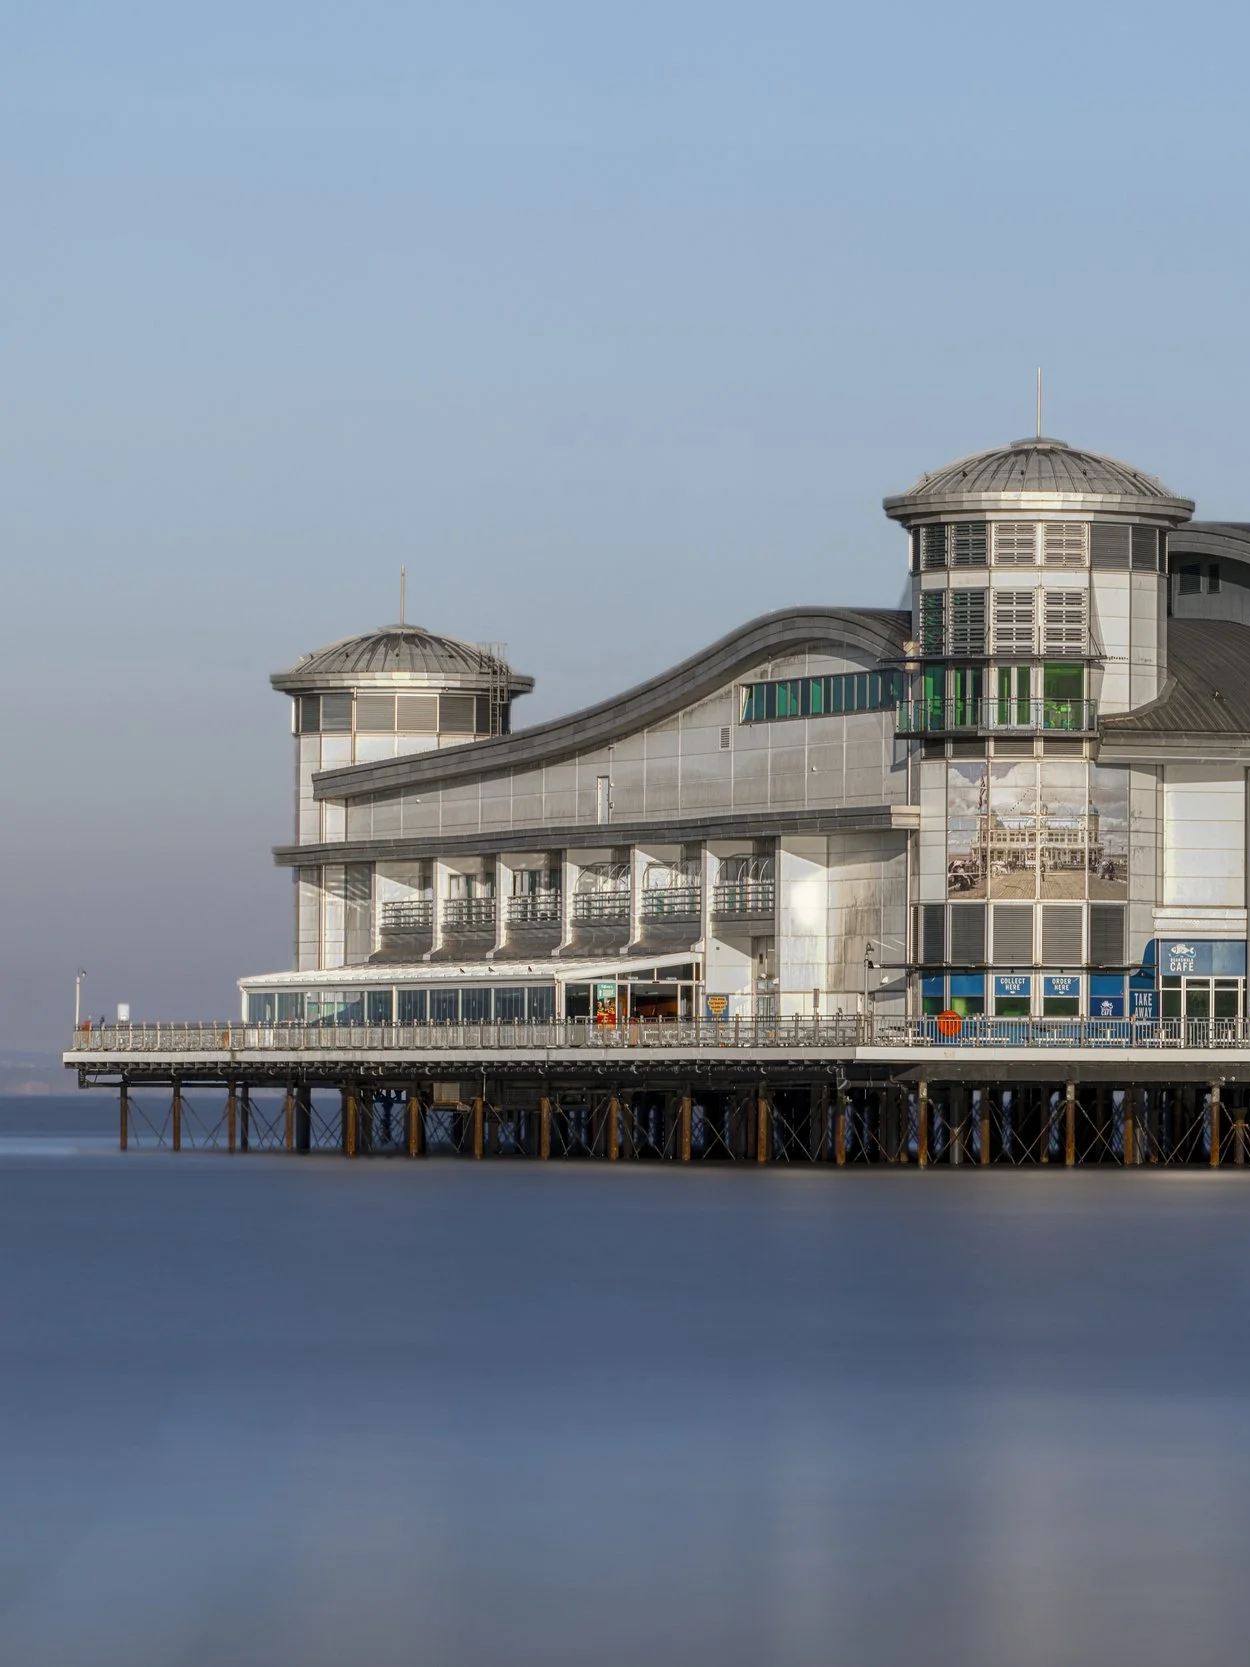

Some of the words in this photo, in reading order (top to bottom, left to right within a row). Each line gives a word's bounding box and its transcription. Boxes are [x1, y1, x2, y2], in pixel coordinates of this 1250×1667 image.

[1000, 977, 1025, 985] COLLECT
[1134, 992, 1153, 1006] TAKE
[1134, 1007, 1153, 1018] AWAY
